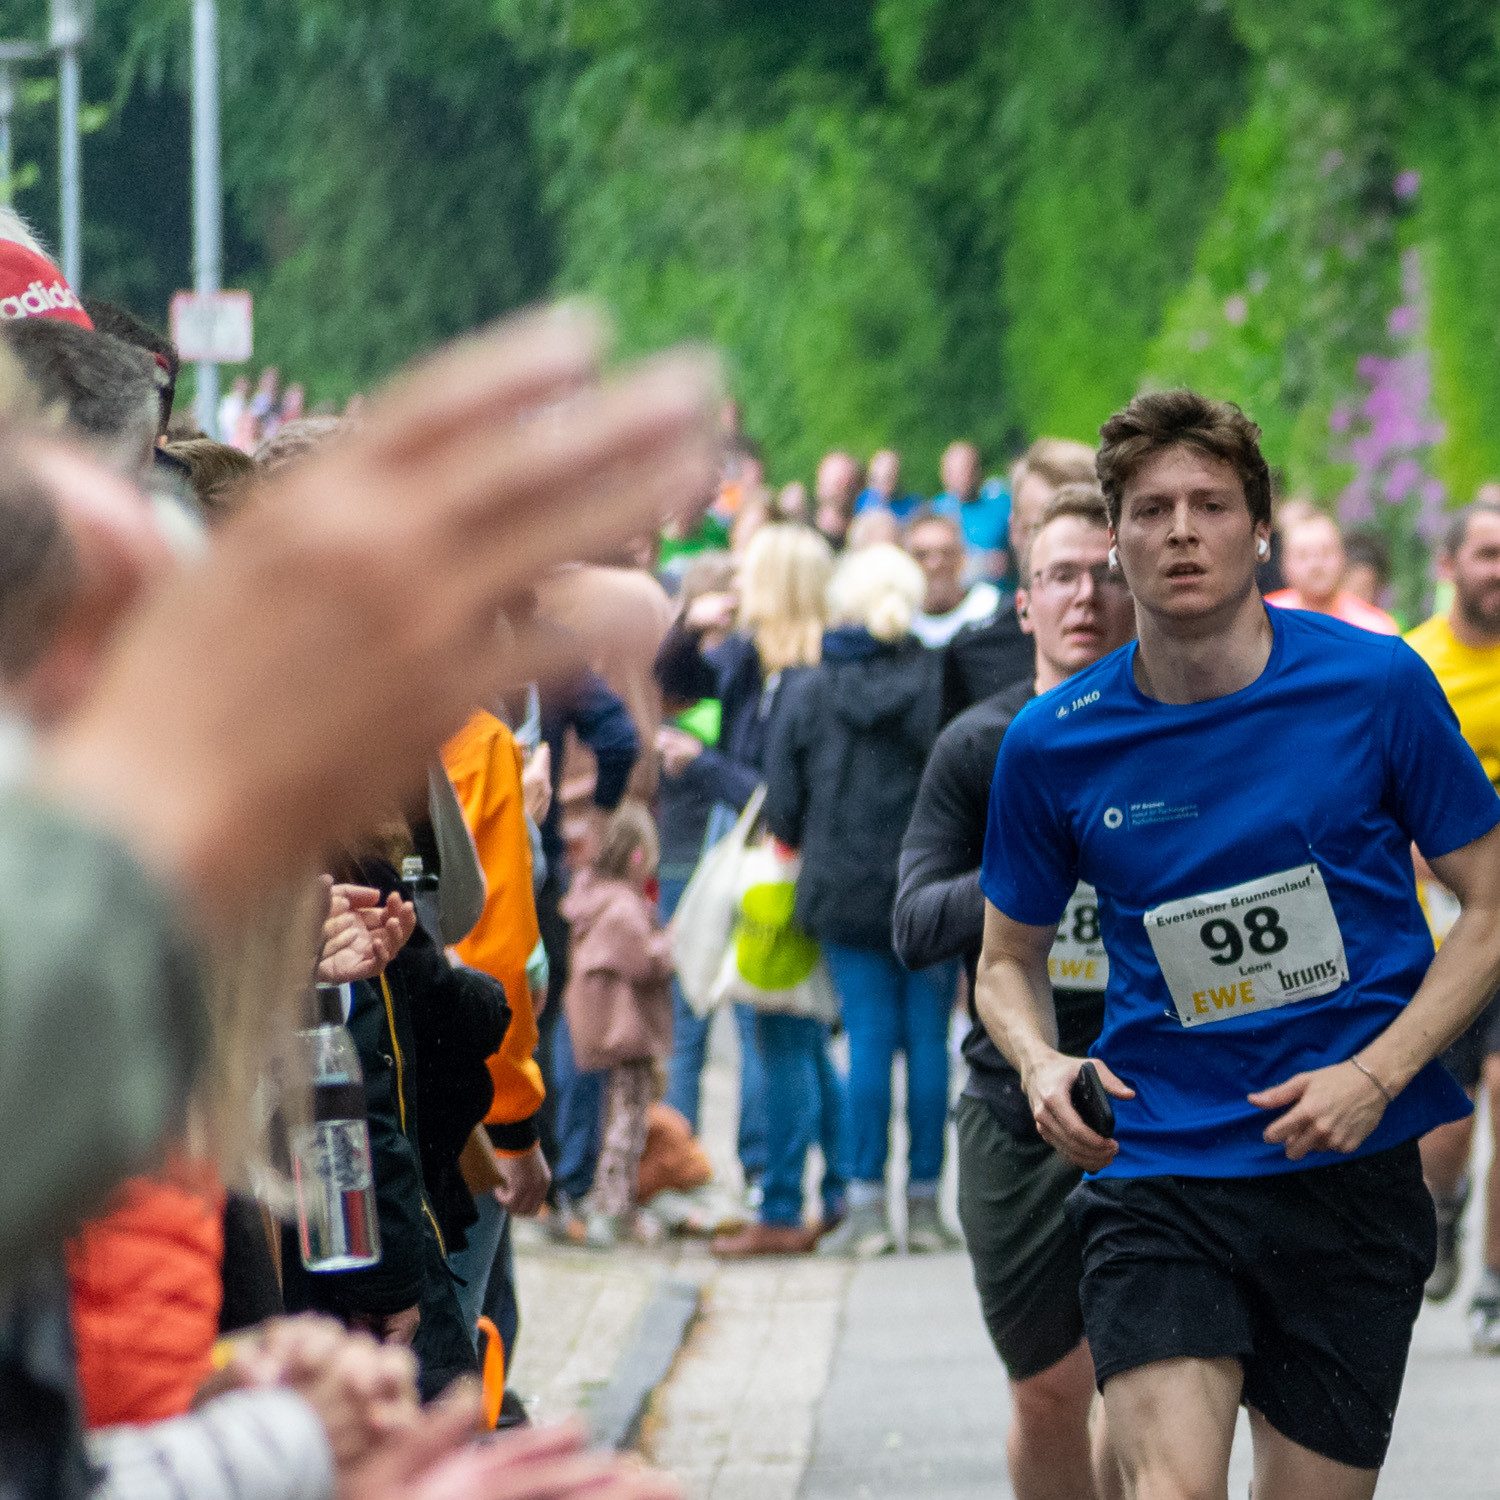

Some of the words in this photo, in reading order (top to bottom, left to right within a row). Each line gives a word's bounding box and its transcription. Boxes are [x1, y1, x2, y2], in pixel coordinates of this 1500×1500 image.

[0, 280, 84, 319] adid
[1072, 689, 1100, 711] JAKO
[1156, 902, 1227, 927] Everstener
[1230, 876, 1311, 908] Brunnenlauf
[1199, 905, 1289, 966] 98
[1048, 959, 1097, 979] EWE
[1192, 979, 1255, 1015] EWE
[1277, 959, 1337, 991] bruns
[1238, 961, 1273, 977] Leon
